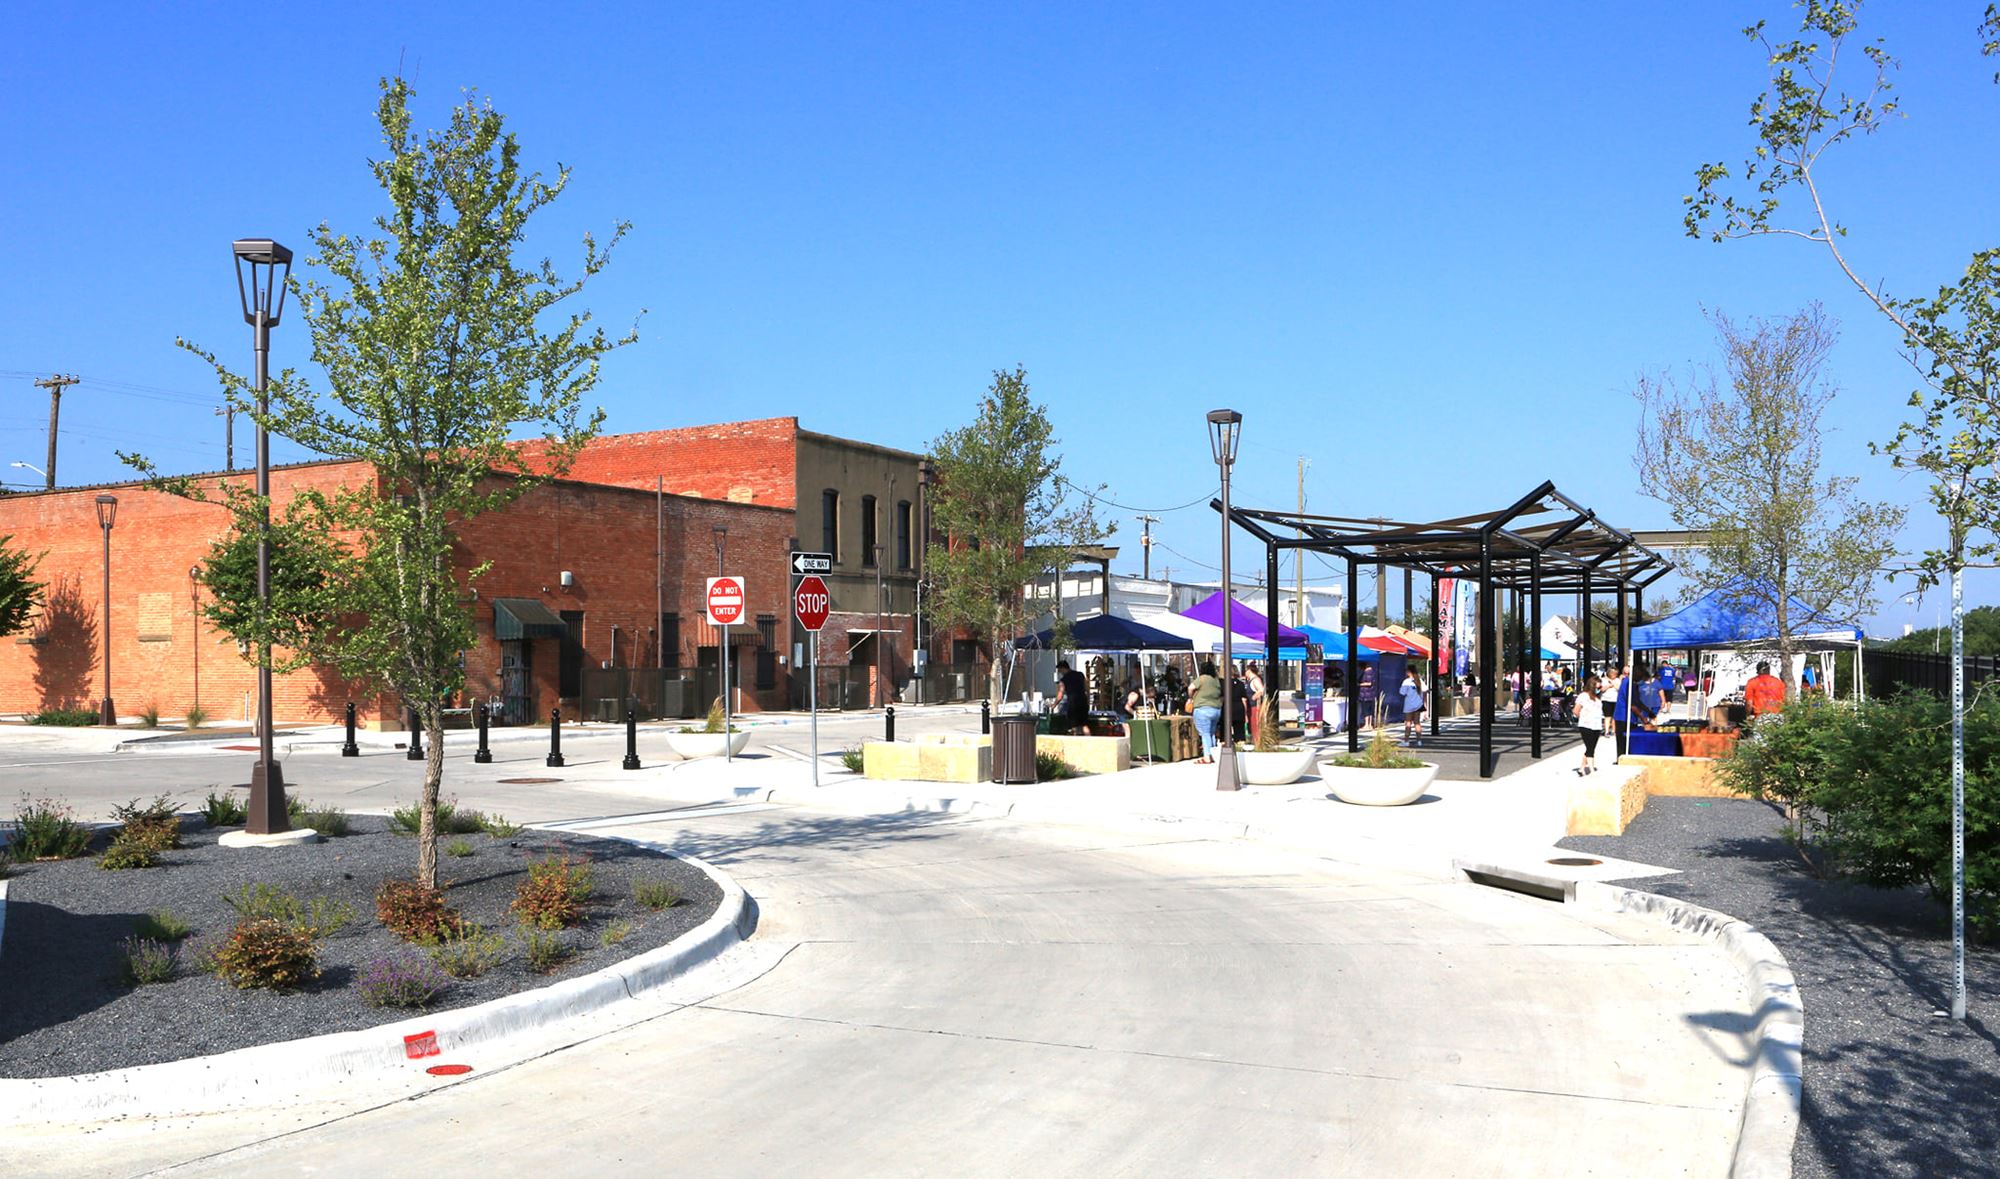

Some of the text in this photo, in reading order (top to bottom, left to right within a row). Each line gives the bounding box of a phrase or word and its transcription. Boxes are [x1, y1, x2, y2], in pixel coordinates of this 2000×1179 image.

[804, 559, 828, 568] ONE WAY
[712, 587, 738, 595] DO NOT
[798, 594, 827, 613] STOP
[715, 607, 736, 615] ENTER
